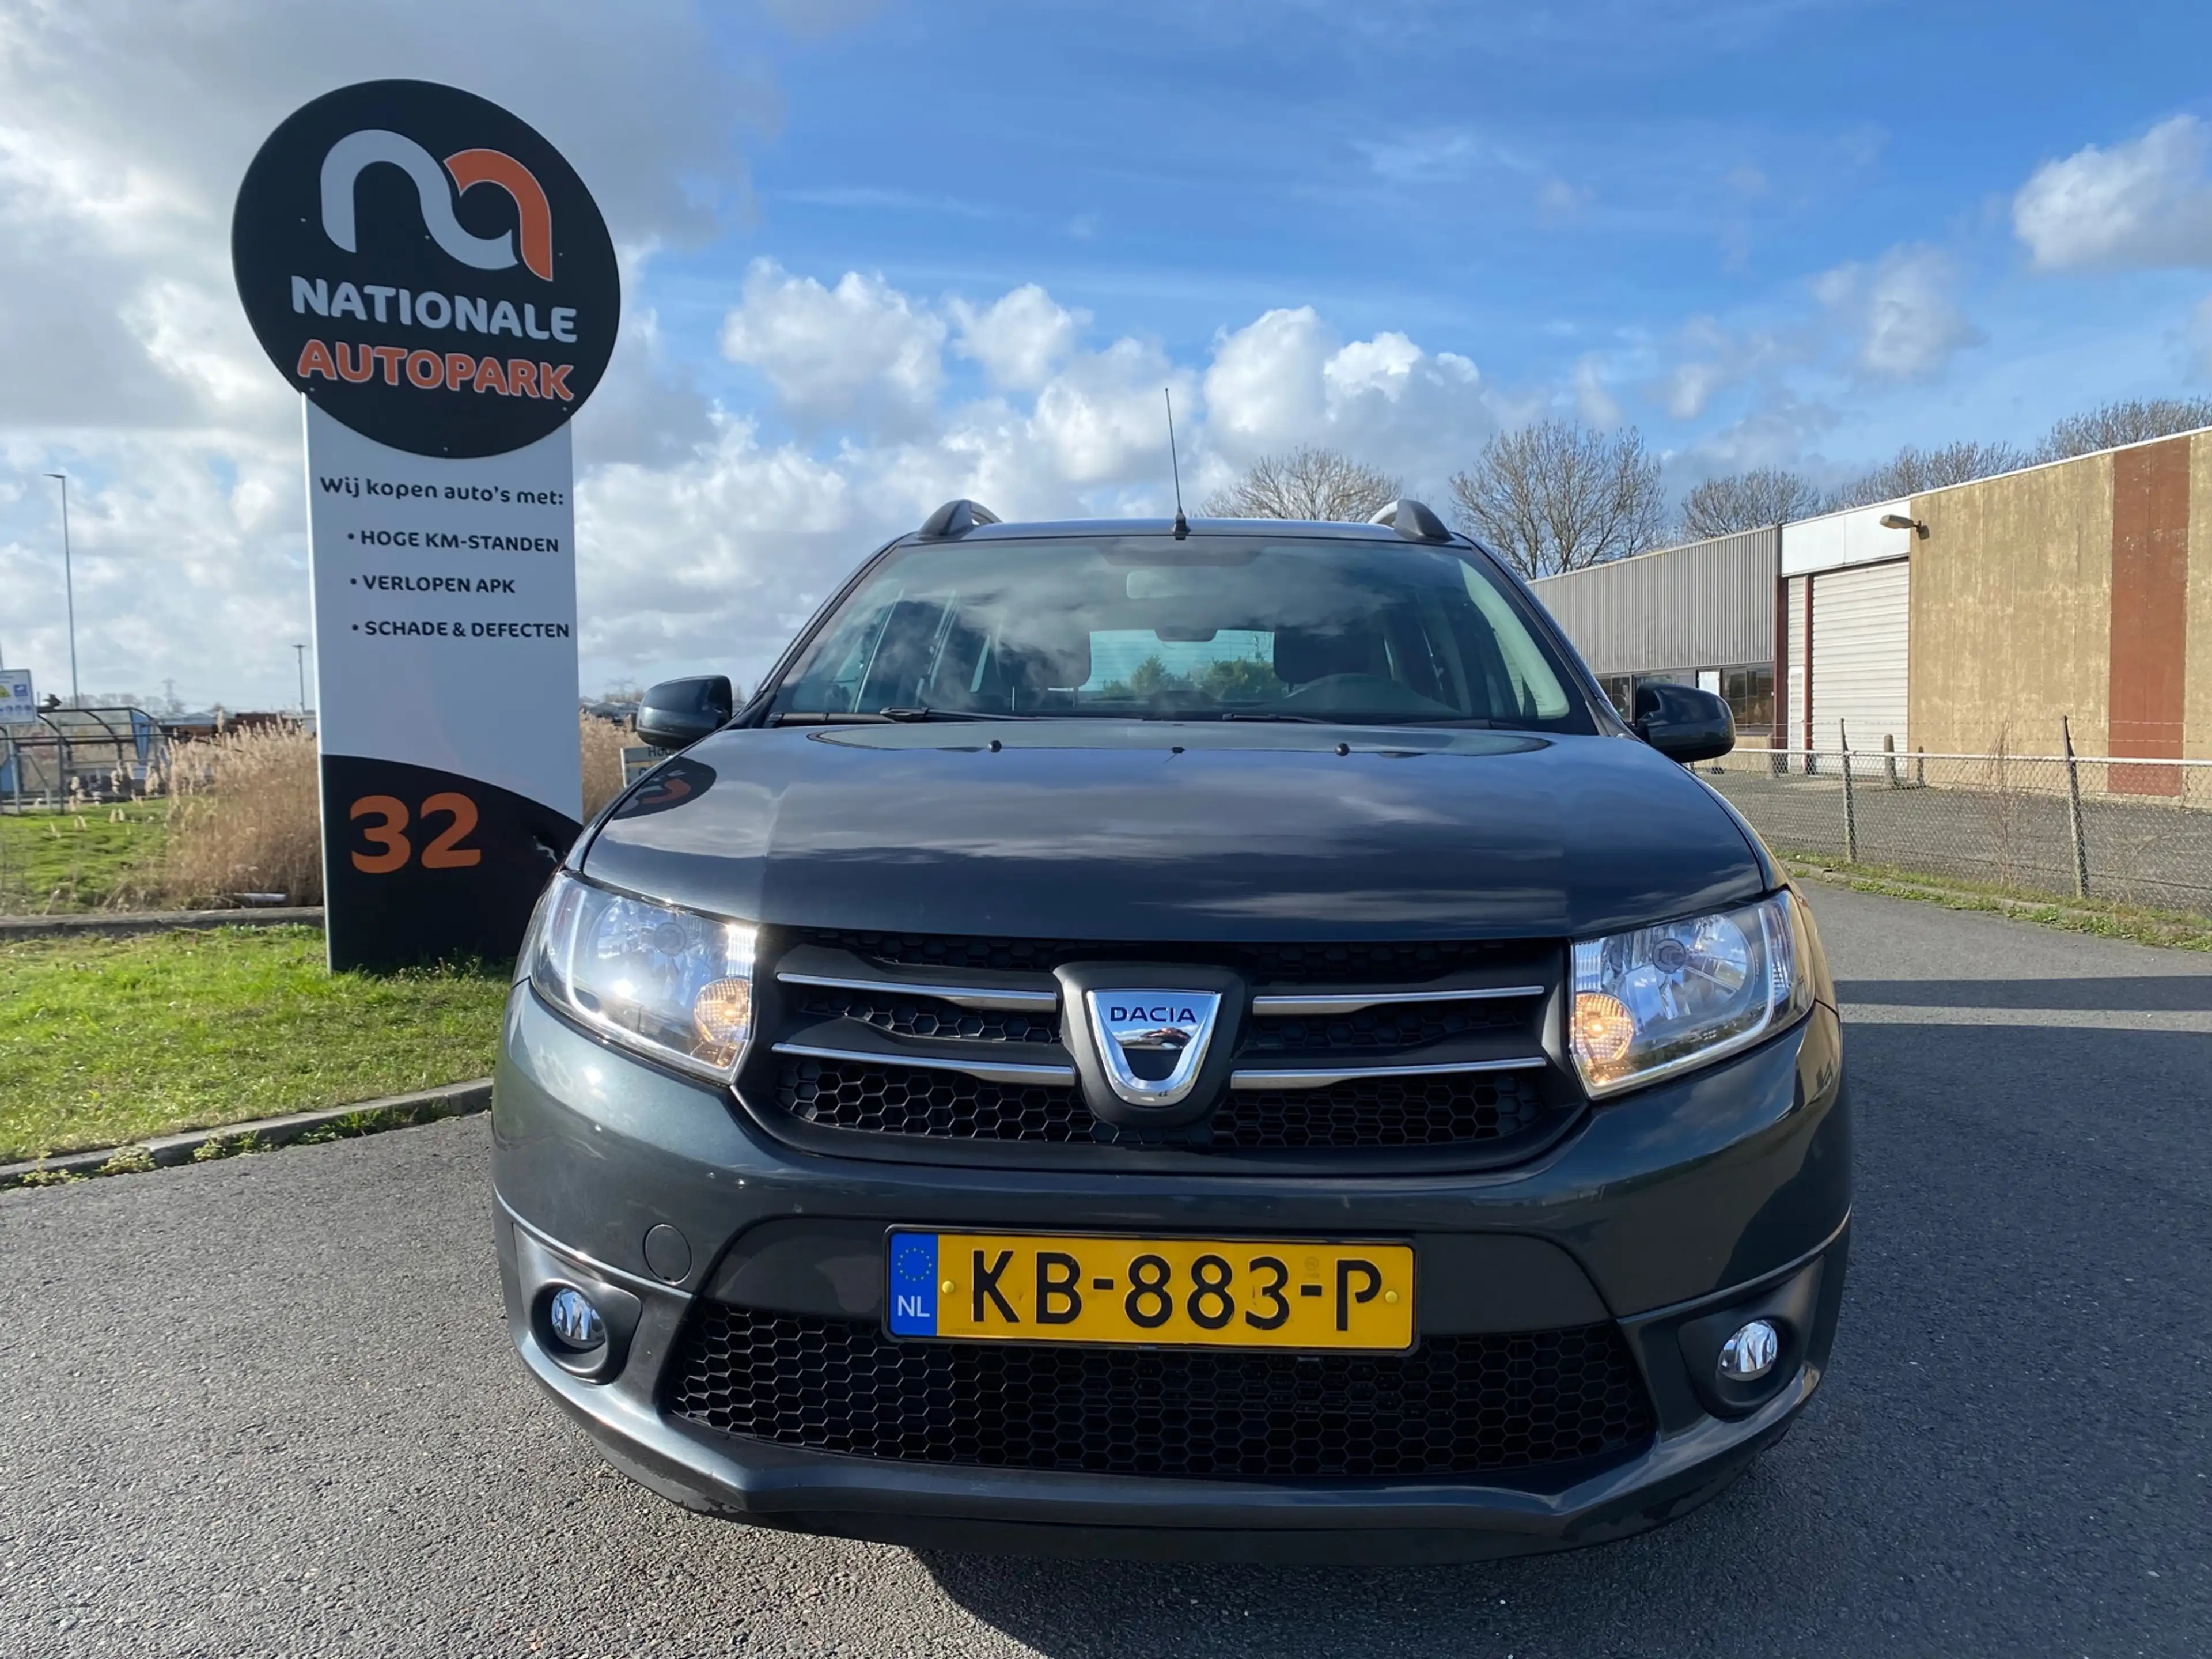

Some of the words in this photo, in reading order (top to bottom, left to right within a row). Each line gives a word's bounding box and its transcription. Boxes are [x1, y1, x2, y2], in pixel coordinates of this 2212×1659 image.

[291, 275, 577, 343] NATIONALE
[297, 339, 575, 402] AUTOPARK
[320, 476, 359, 498] Wij
[366, 479, 437, 499] kopen
[444, 486, 510, 504] auto's
[517, 490, 563, 505] met:
[361, 531, 419, 547] HOGE
[425, 533, 559, 552] KM-STANDEN
[363, 575, 471, 593] VERLOPEN
[476, 579, 516, 593] APK
[365, 621, 448, 636] SCHADE
[452, 623, 466, 637] &
[471, 623, 569, 638] DEFECTEN
[350, 792, 482, 874] 32
[1111, 1006, 1196, 1023] DACIA
[897, 1294, 930, 1318] NL
[971, 1249, 1382, 1332] KB-883-P
